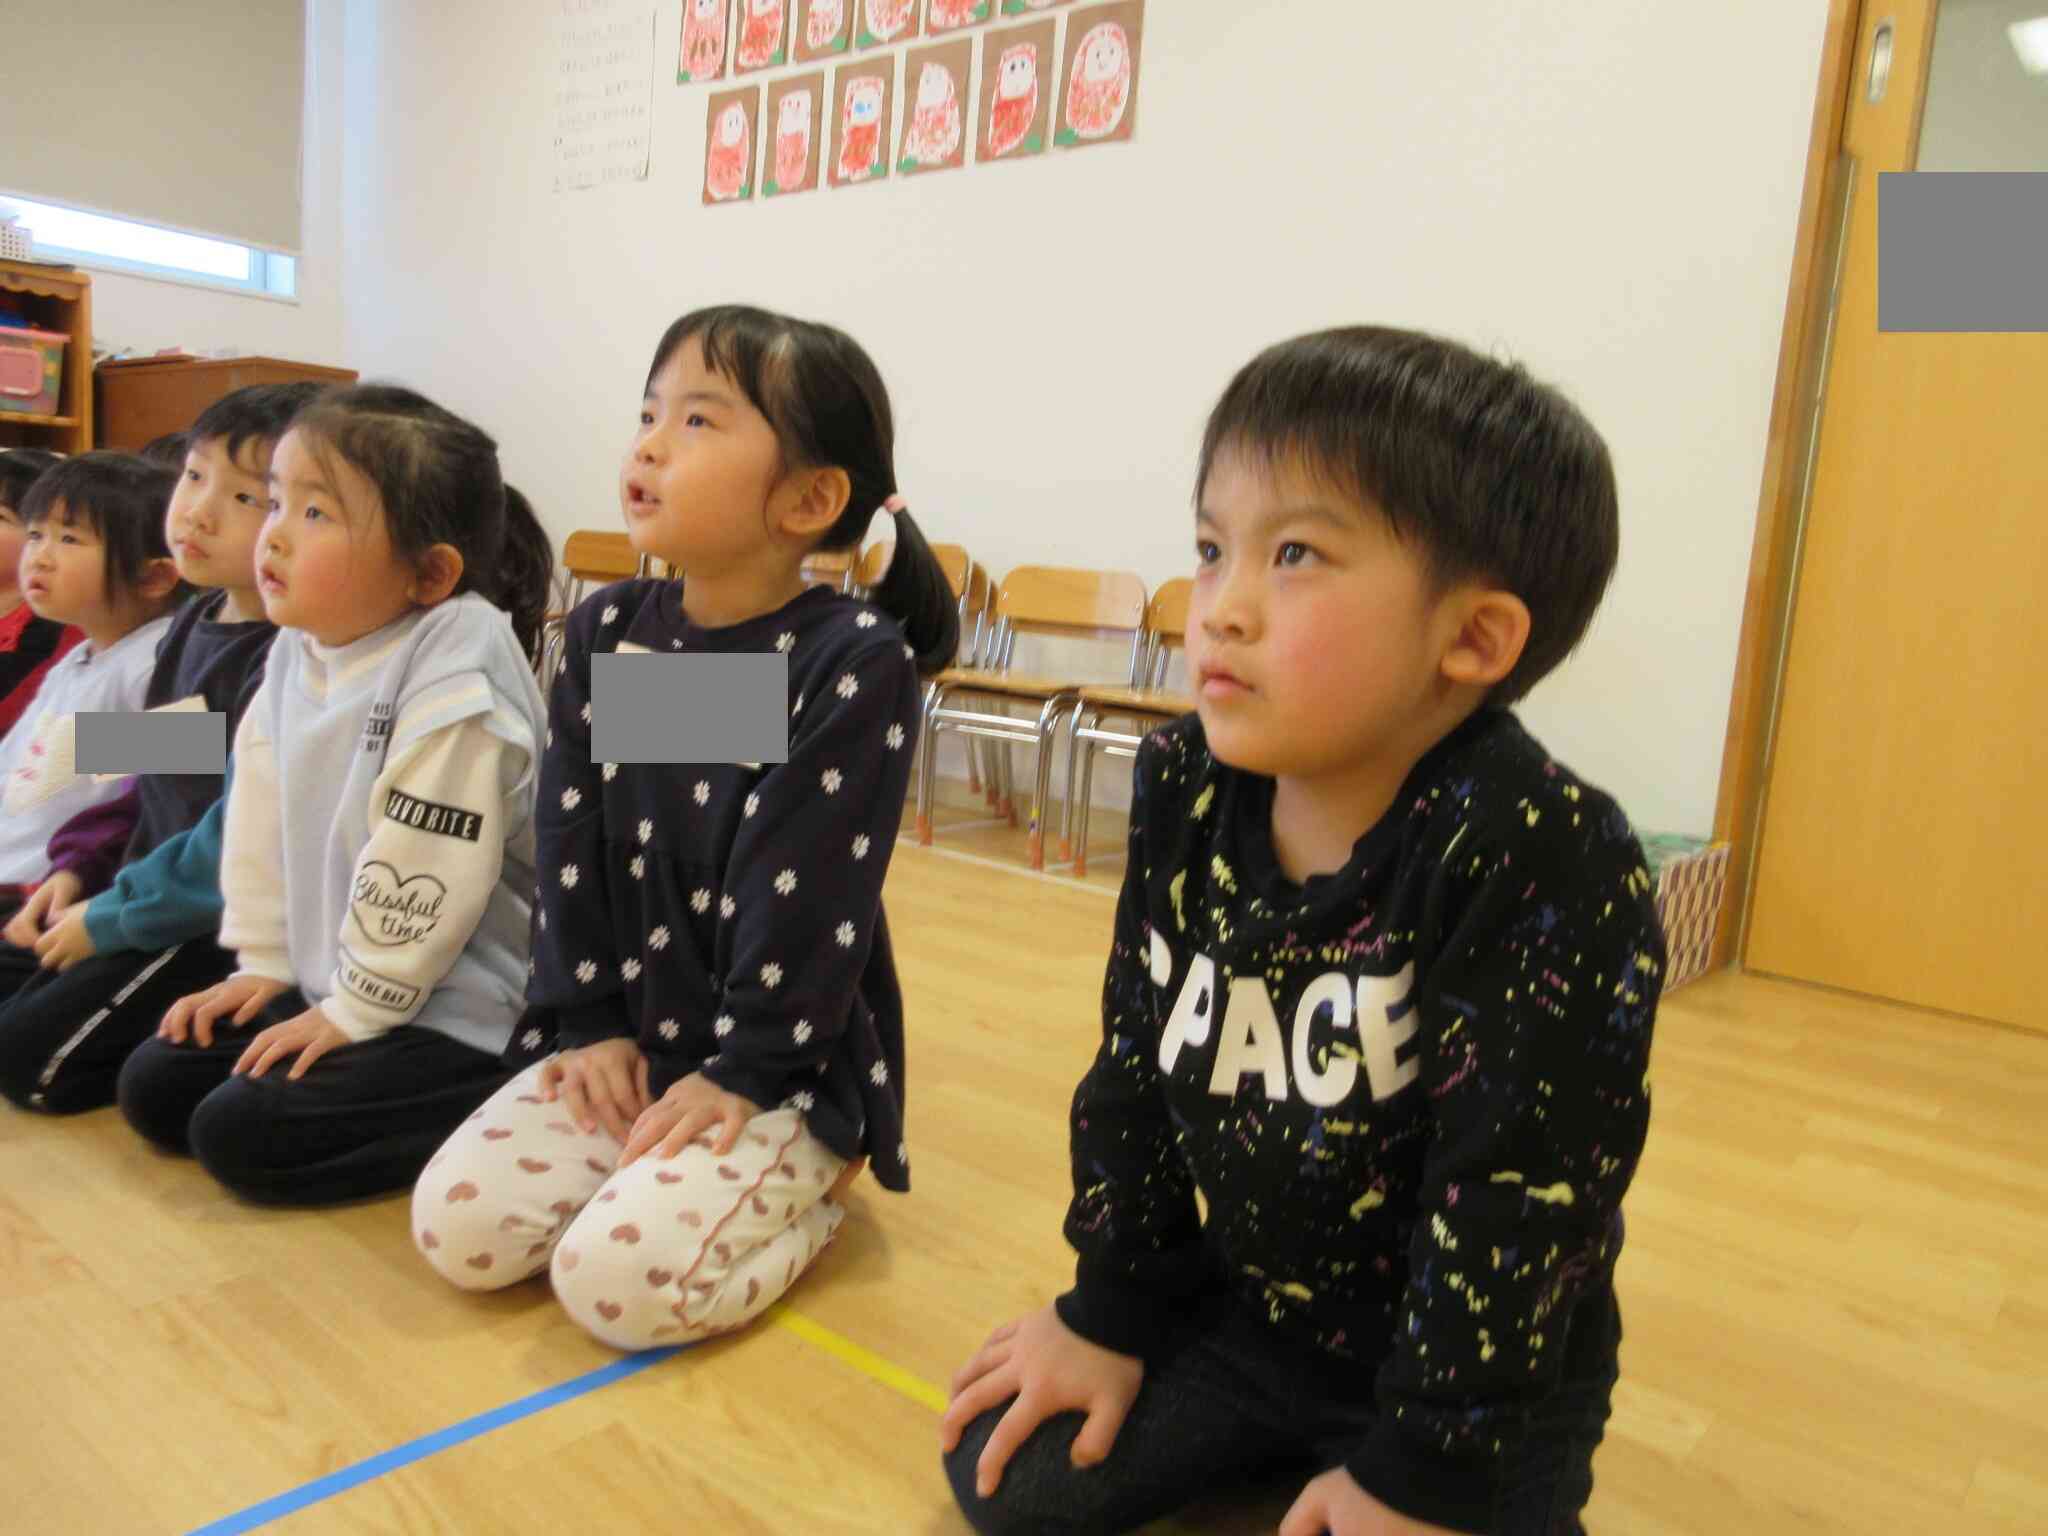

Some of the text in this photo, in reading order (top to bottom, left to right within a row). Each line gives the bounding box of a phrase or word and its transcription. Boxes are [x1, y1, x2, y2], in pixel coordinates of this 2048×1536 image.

[386, 792, 475, 839] FAVORITE
[352, 874, 443, 921] Blissful
[381, 913, 427, 943] time
